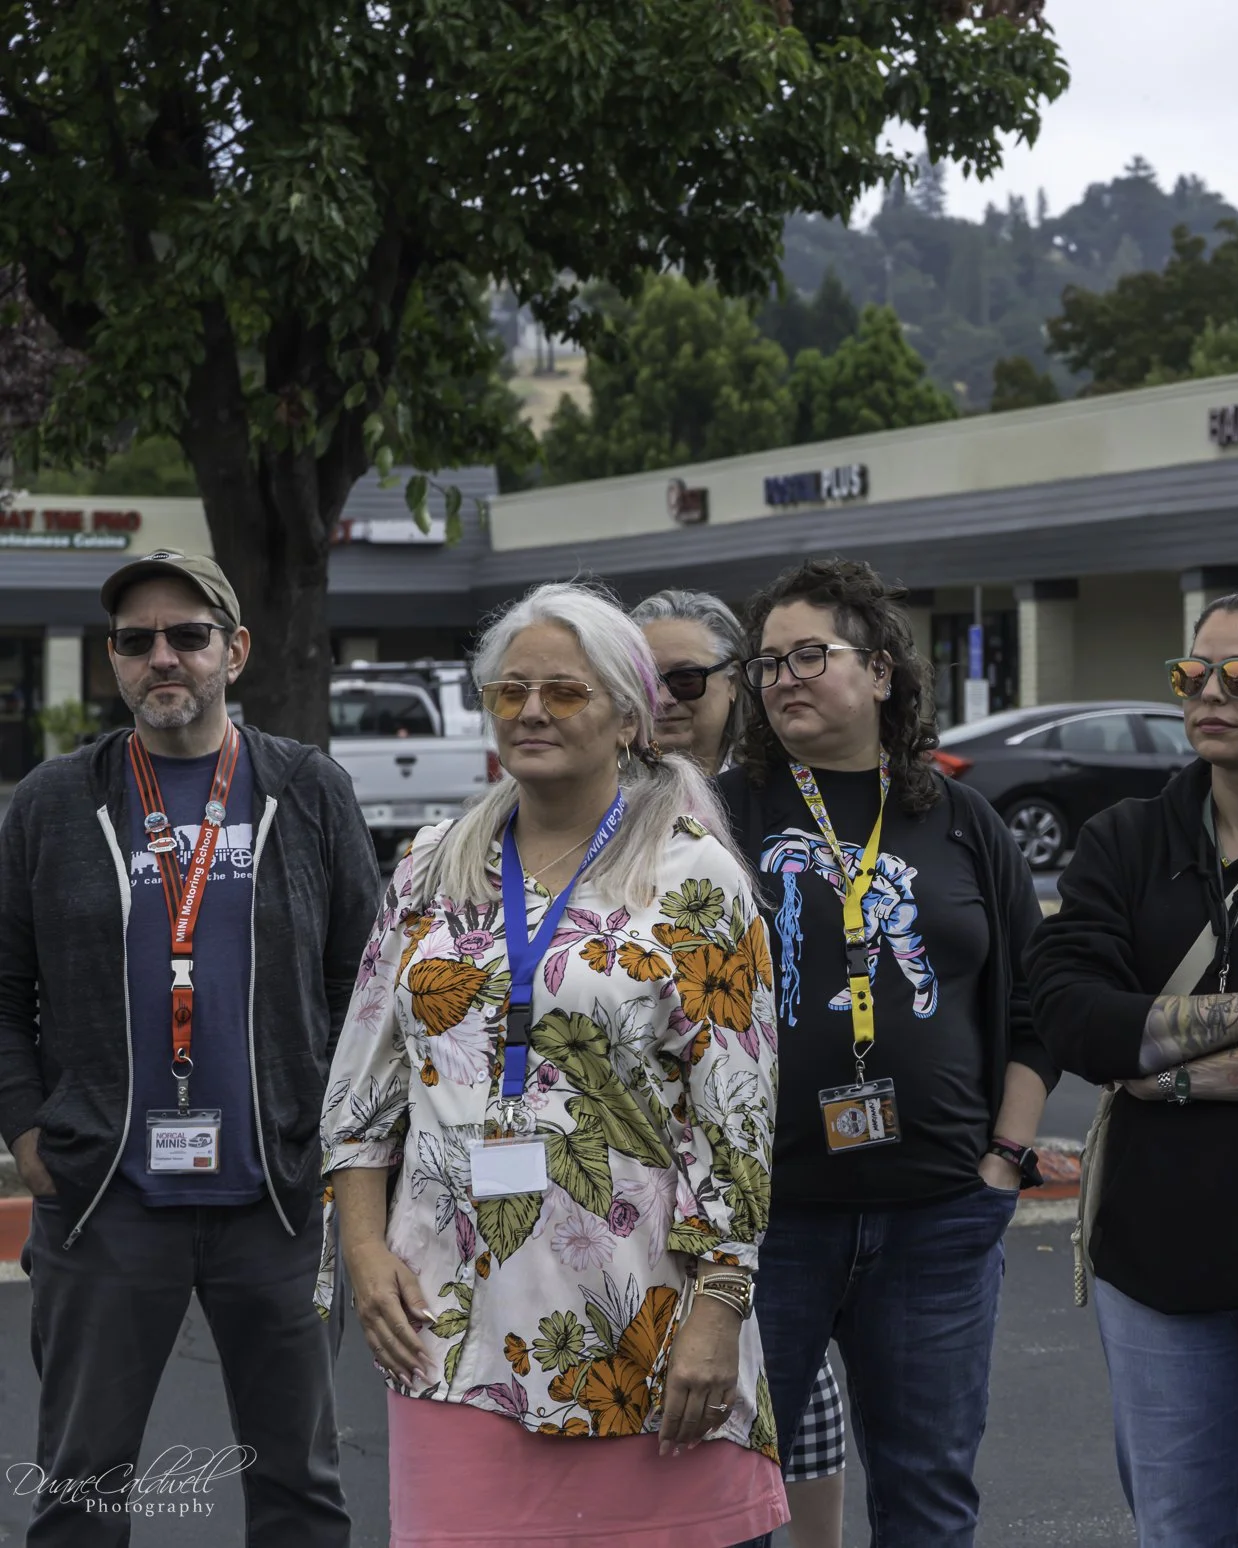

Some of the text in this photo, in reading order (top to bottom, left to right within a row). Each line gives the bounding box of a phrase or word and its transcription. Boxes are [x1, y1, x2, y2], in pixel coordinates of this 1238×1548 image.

[821, 463, 866, 499] PLUS
[43, 509, 84, 531] THE
[176, 828, 214, 942] MINI Motoring School
[207, 872, 226, 881] the
[155, 1139, 187, 1149] MINIS
